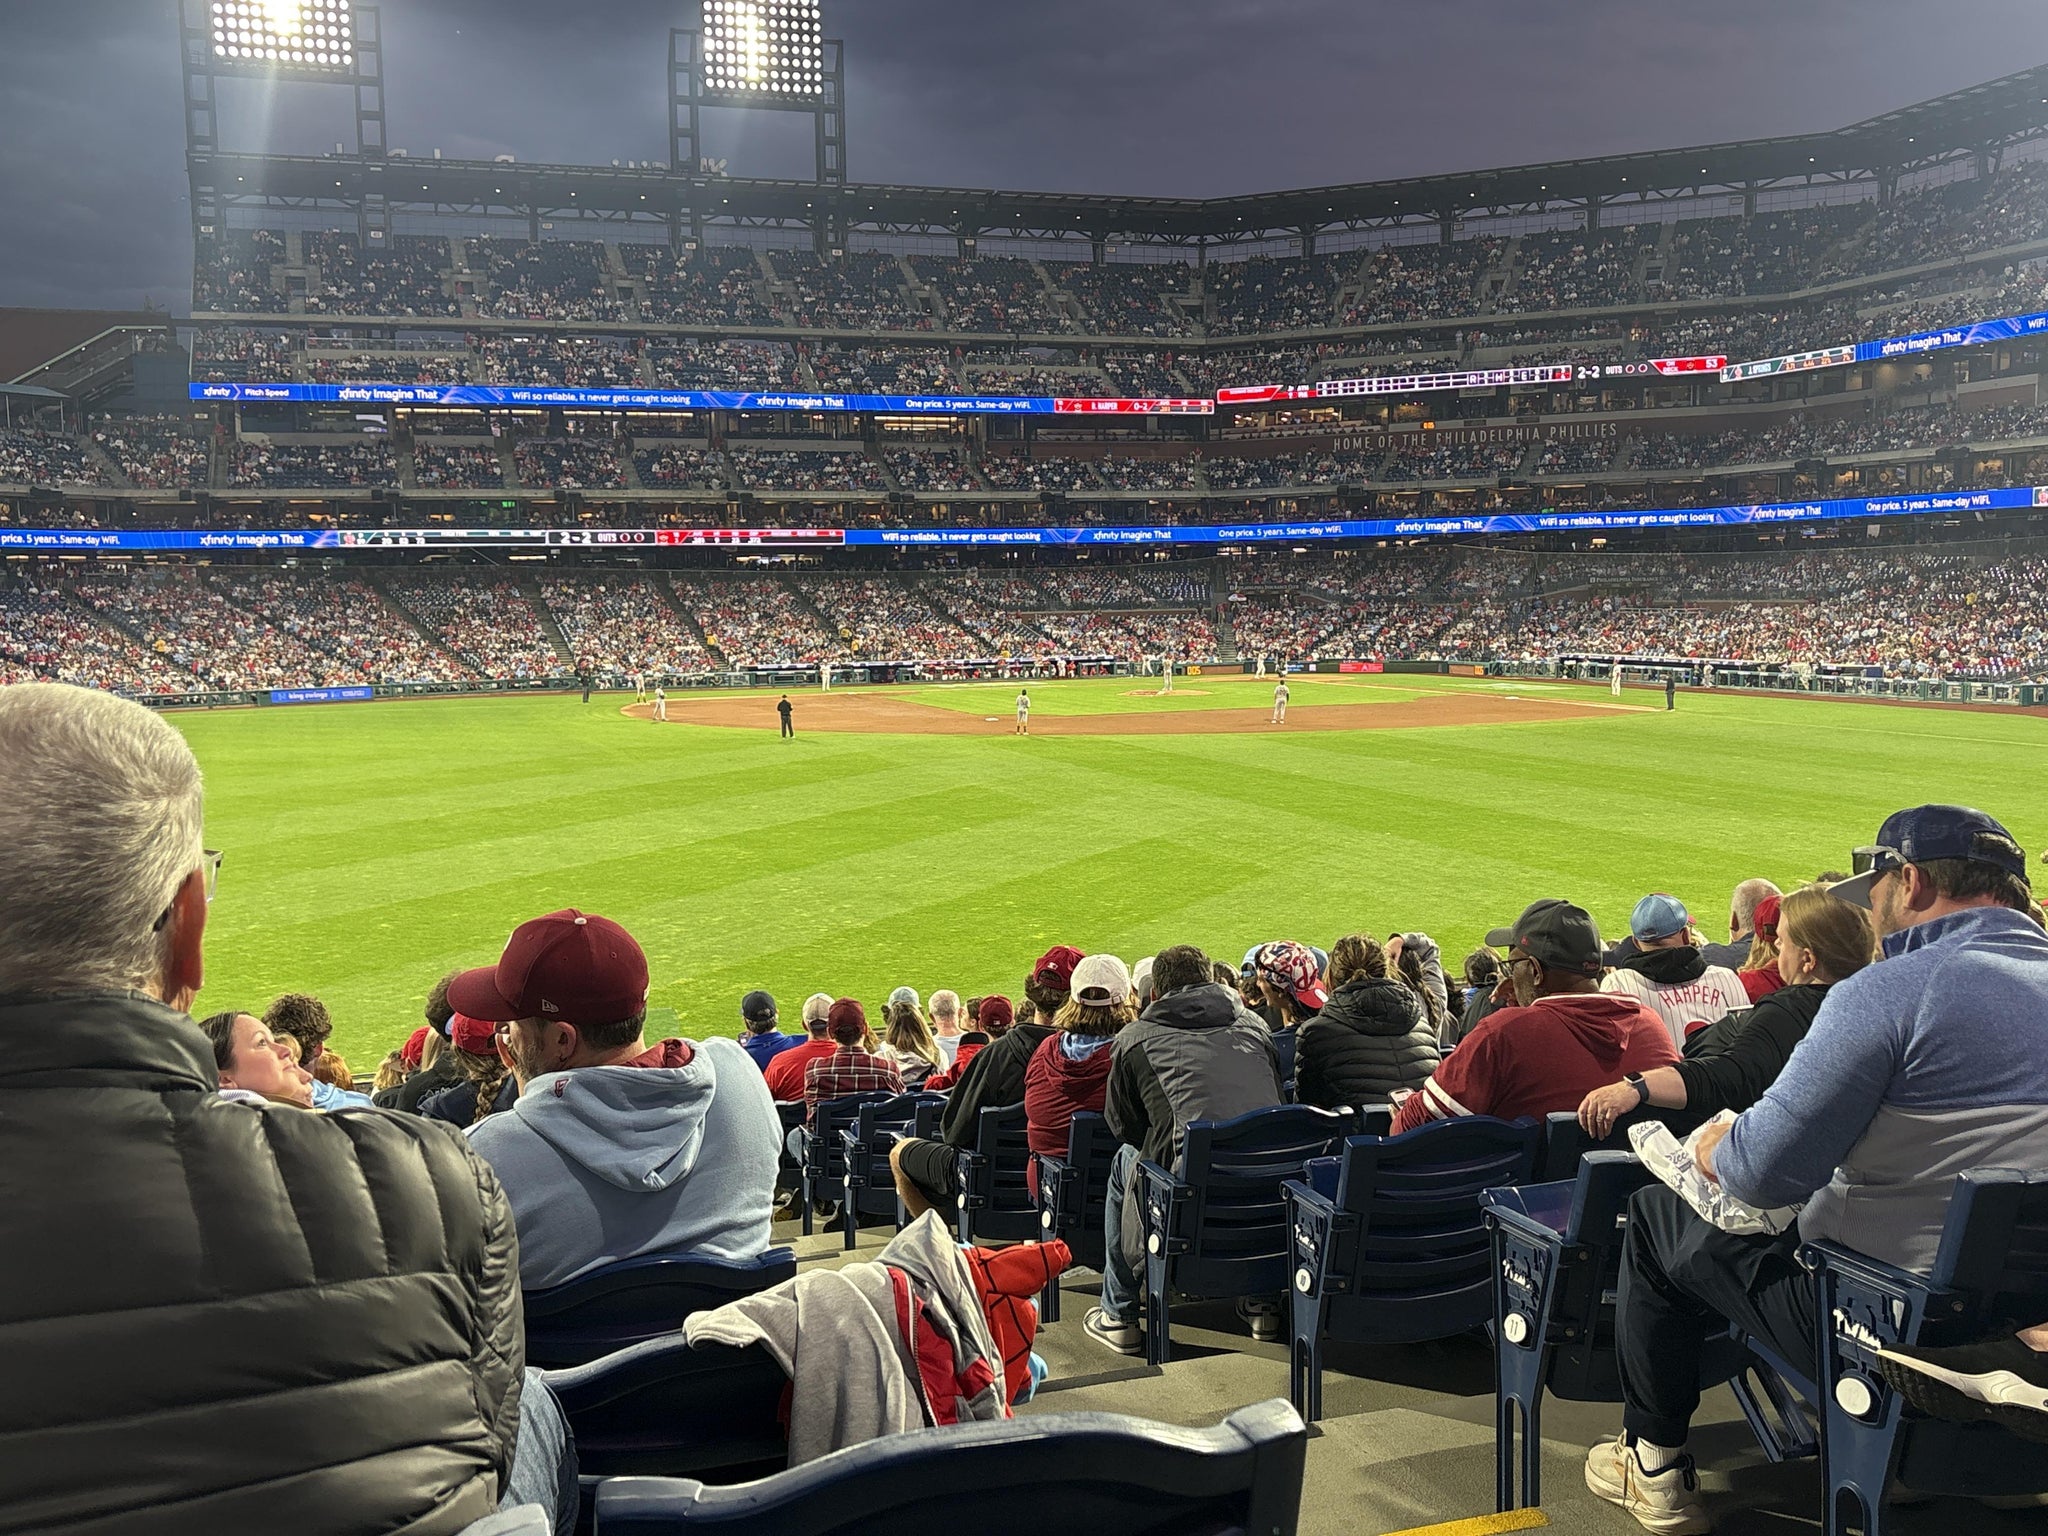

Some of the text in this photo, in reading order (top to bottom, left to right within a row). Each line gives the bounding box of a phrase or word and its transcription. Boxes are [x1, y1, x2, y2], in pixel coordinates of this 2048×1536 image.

[2028, 319, 2045, 329] WiFi
[1882, 332, 1961, 355] xfinity Imagine That
[1605, 365, 1623, 374] OUTS
[1705, 359, 1718, 368] 53
[1577, 366, 1600, 379] 2-2
[203, 387, 289, 399] xfinity Pitch Speed
[339, 389, 438, 402] xfinity Imagine That
[511, 391, 530, 400] WiFi
[544, 392, 578, 402] reliable,
[579, 393, 586, 401] it
[613, 395, 630, 405] gets
[631, 394, 659, 405] caught
[660, 395, 691, 406] looking
[757, 397, 844, 410] xfinity Imagine That
[906, 400, 922, 408] One
[923, 400, 944, 410] price.
[951, 403, 974, 411] years.
[976, 401, 1013, 412] Same-day
[1334, 422, 1617, 451] HOME OF THE PHILADELPHIA PHILLIES
[1866, 501, 1880, 511] One
[1881, 501, 1901, 512] price.
[1903, 499, 1908, 508] 5
[1909, 499, 1931, 509] years.
[1932, 496, 1971, 508] Same-day
[1539, 516, 1557, 526] WiFi
[1570, 515, 1604, 525] reliable,
[1639, 514, 1657, 524] gets
[1659, 512, 1688, 523] caught
[1689, 511, 1715, 523] looking
[1777, 507, 1805, 518] Imagine
[1806, 506, 1822, 515] That
[1218, 529, 1234, 538] One
[1235, 529, 1255, 540] price.
[1257, 528, 1262, 536] 5
[1263, 528, 1285, 539] years.
[1286, 526, 1324, 538] Same-day
[1395, 520, 1483, 533] xfinity Imagine That
[1, 535, 25, 546] price.
[27, 535, 33, 543] 5
[34, 537, 59, 547] years.
[60, 535, 100, 547] Same-day
[200, 533, 304, 547] xfinity Imagine That
[597, 533, 617, 542] OUTS
[882, 533, 899, 541] WiFi
[910, 533, 941, 542] reliable,
[971, 534, 987, 543] gets
[988, 533, 1013, 543] caught
[1013, 532, 1041, 543] looking
[1093, 530, 1172, 541] xfinity Imagine That
[1658, 984, 1721, 1009] HARPER
